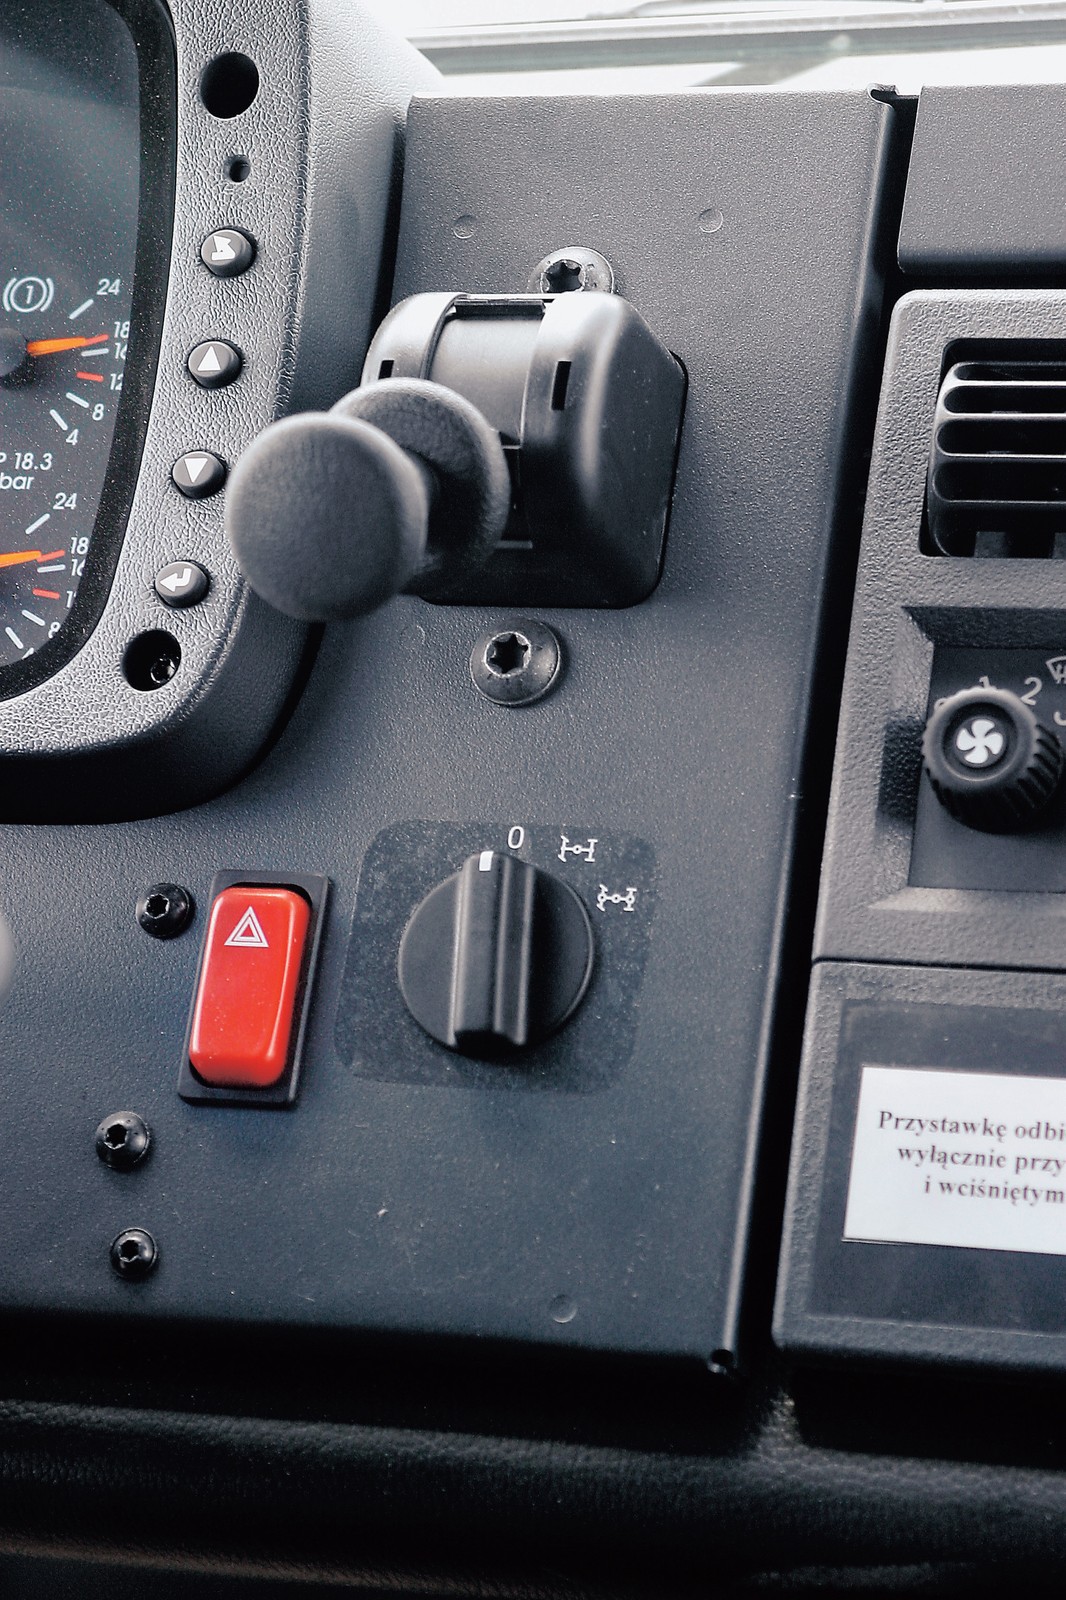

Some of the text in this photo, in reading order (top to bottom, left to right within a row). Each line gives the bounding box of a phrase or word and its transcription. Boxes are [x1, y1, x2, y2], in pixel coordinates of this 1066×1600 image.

[96, 278, 121, 296] 24
[113, 320, 131, 339] 18
[92, 403, 105, 421] 8
[65, 428, 79, 446] 4
[14, 452, 53, 471] 18.3
[0, 471, 35, 490] bar
[52, 492, 77, 510] 24
[70, 536, 89, 555] 18
[1020, 676, 1043, 706] 2
[507, 825, 525, 850] 0
[878, 1110, 1007, 1143] Przystawkę
[897, 1145, 1066, 1178] wyłącznie przy
[924, 1175, 1065, 1207] i wciśniętym
